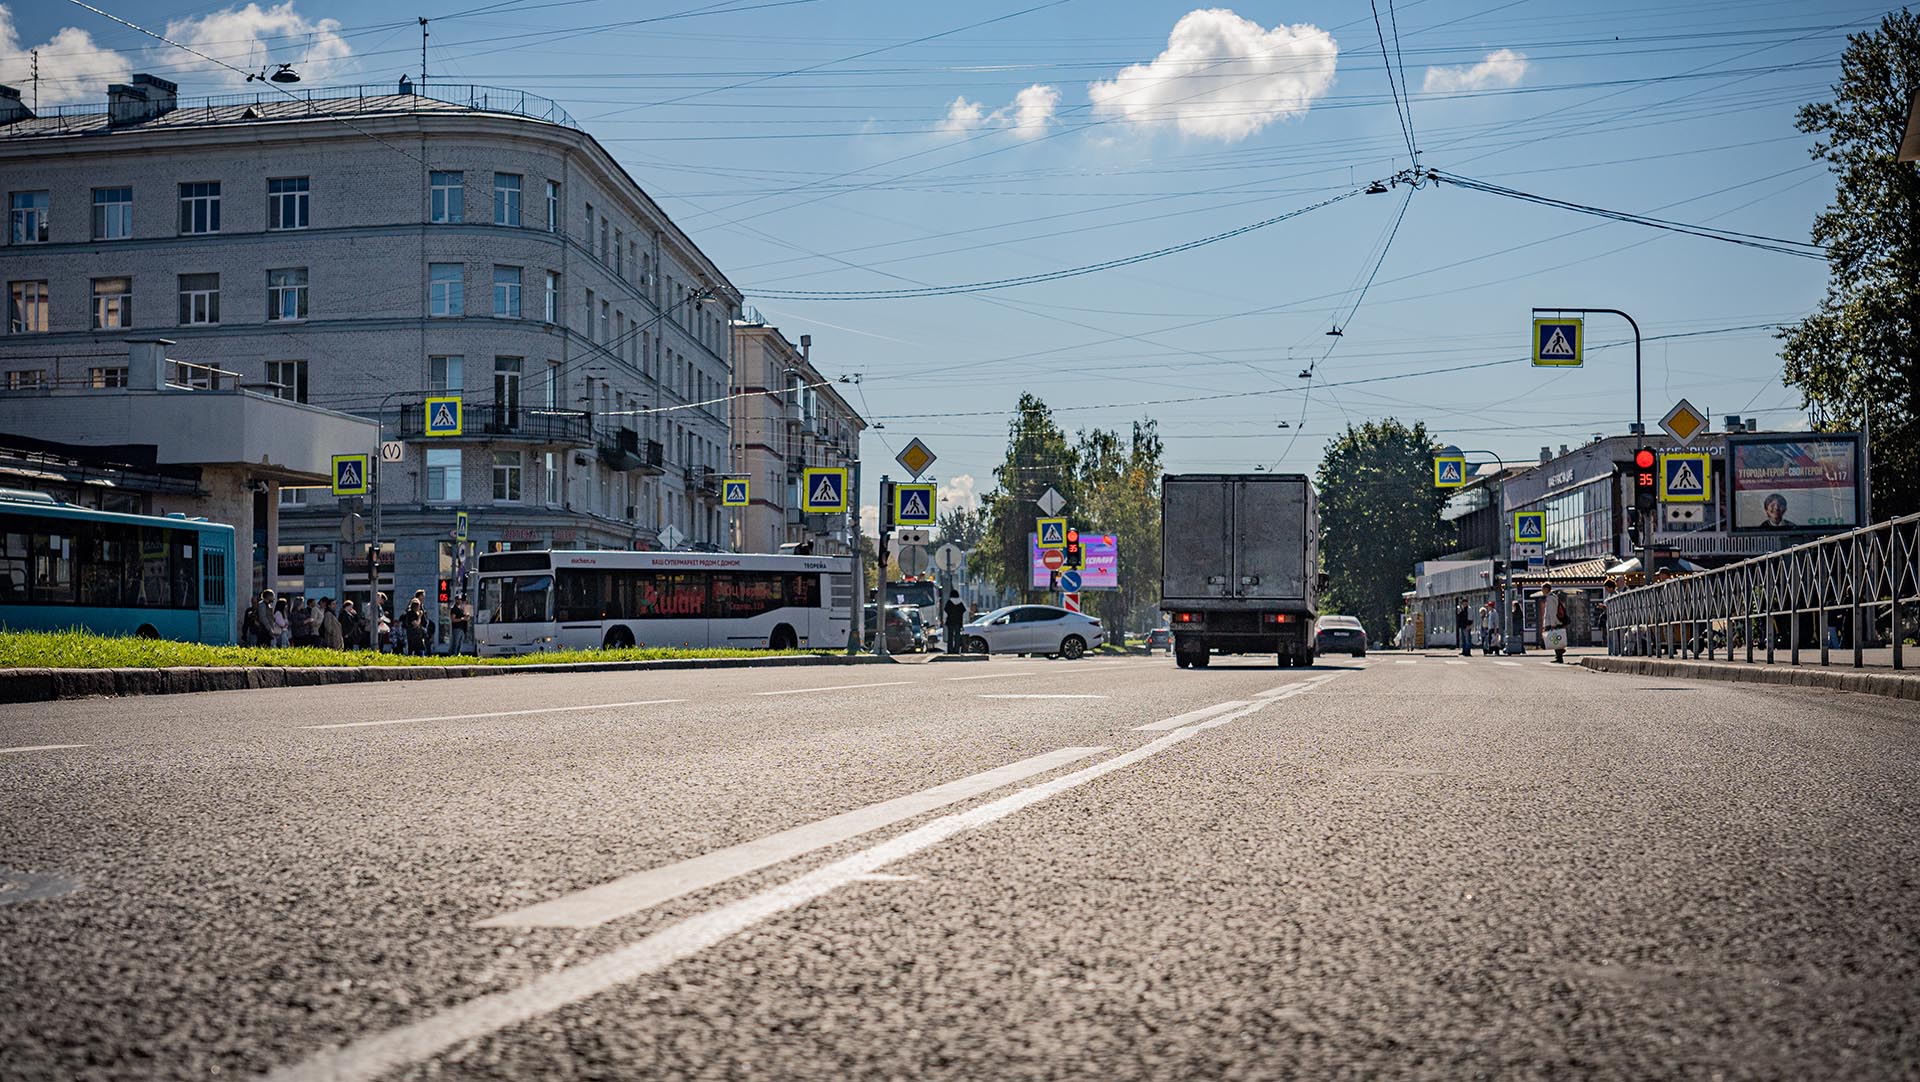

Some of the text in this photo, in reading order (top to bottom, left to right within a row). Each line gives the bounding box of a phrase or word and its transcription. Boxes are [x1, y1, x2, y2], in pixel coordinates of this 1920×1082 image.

[1640, 474, 1653, 485] 35
[1069, 544, 1078, 553] 35
[440, 593, 448, 601] 05
